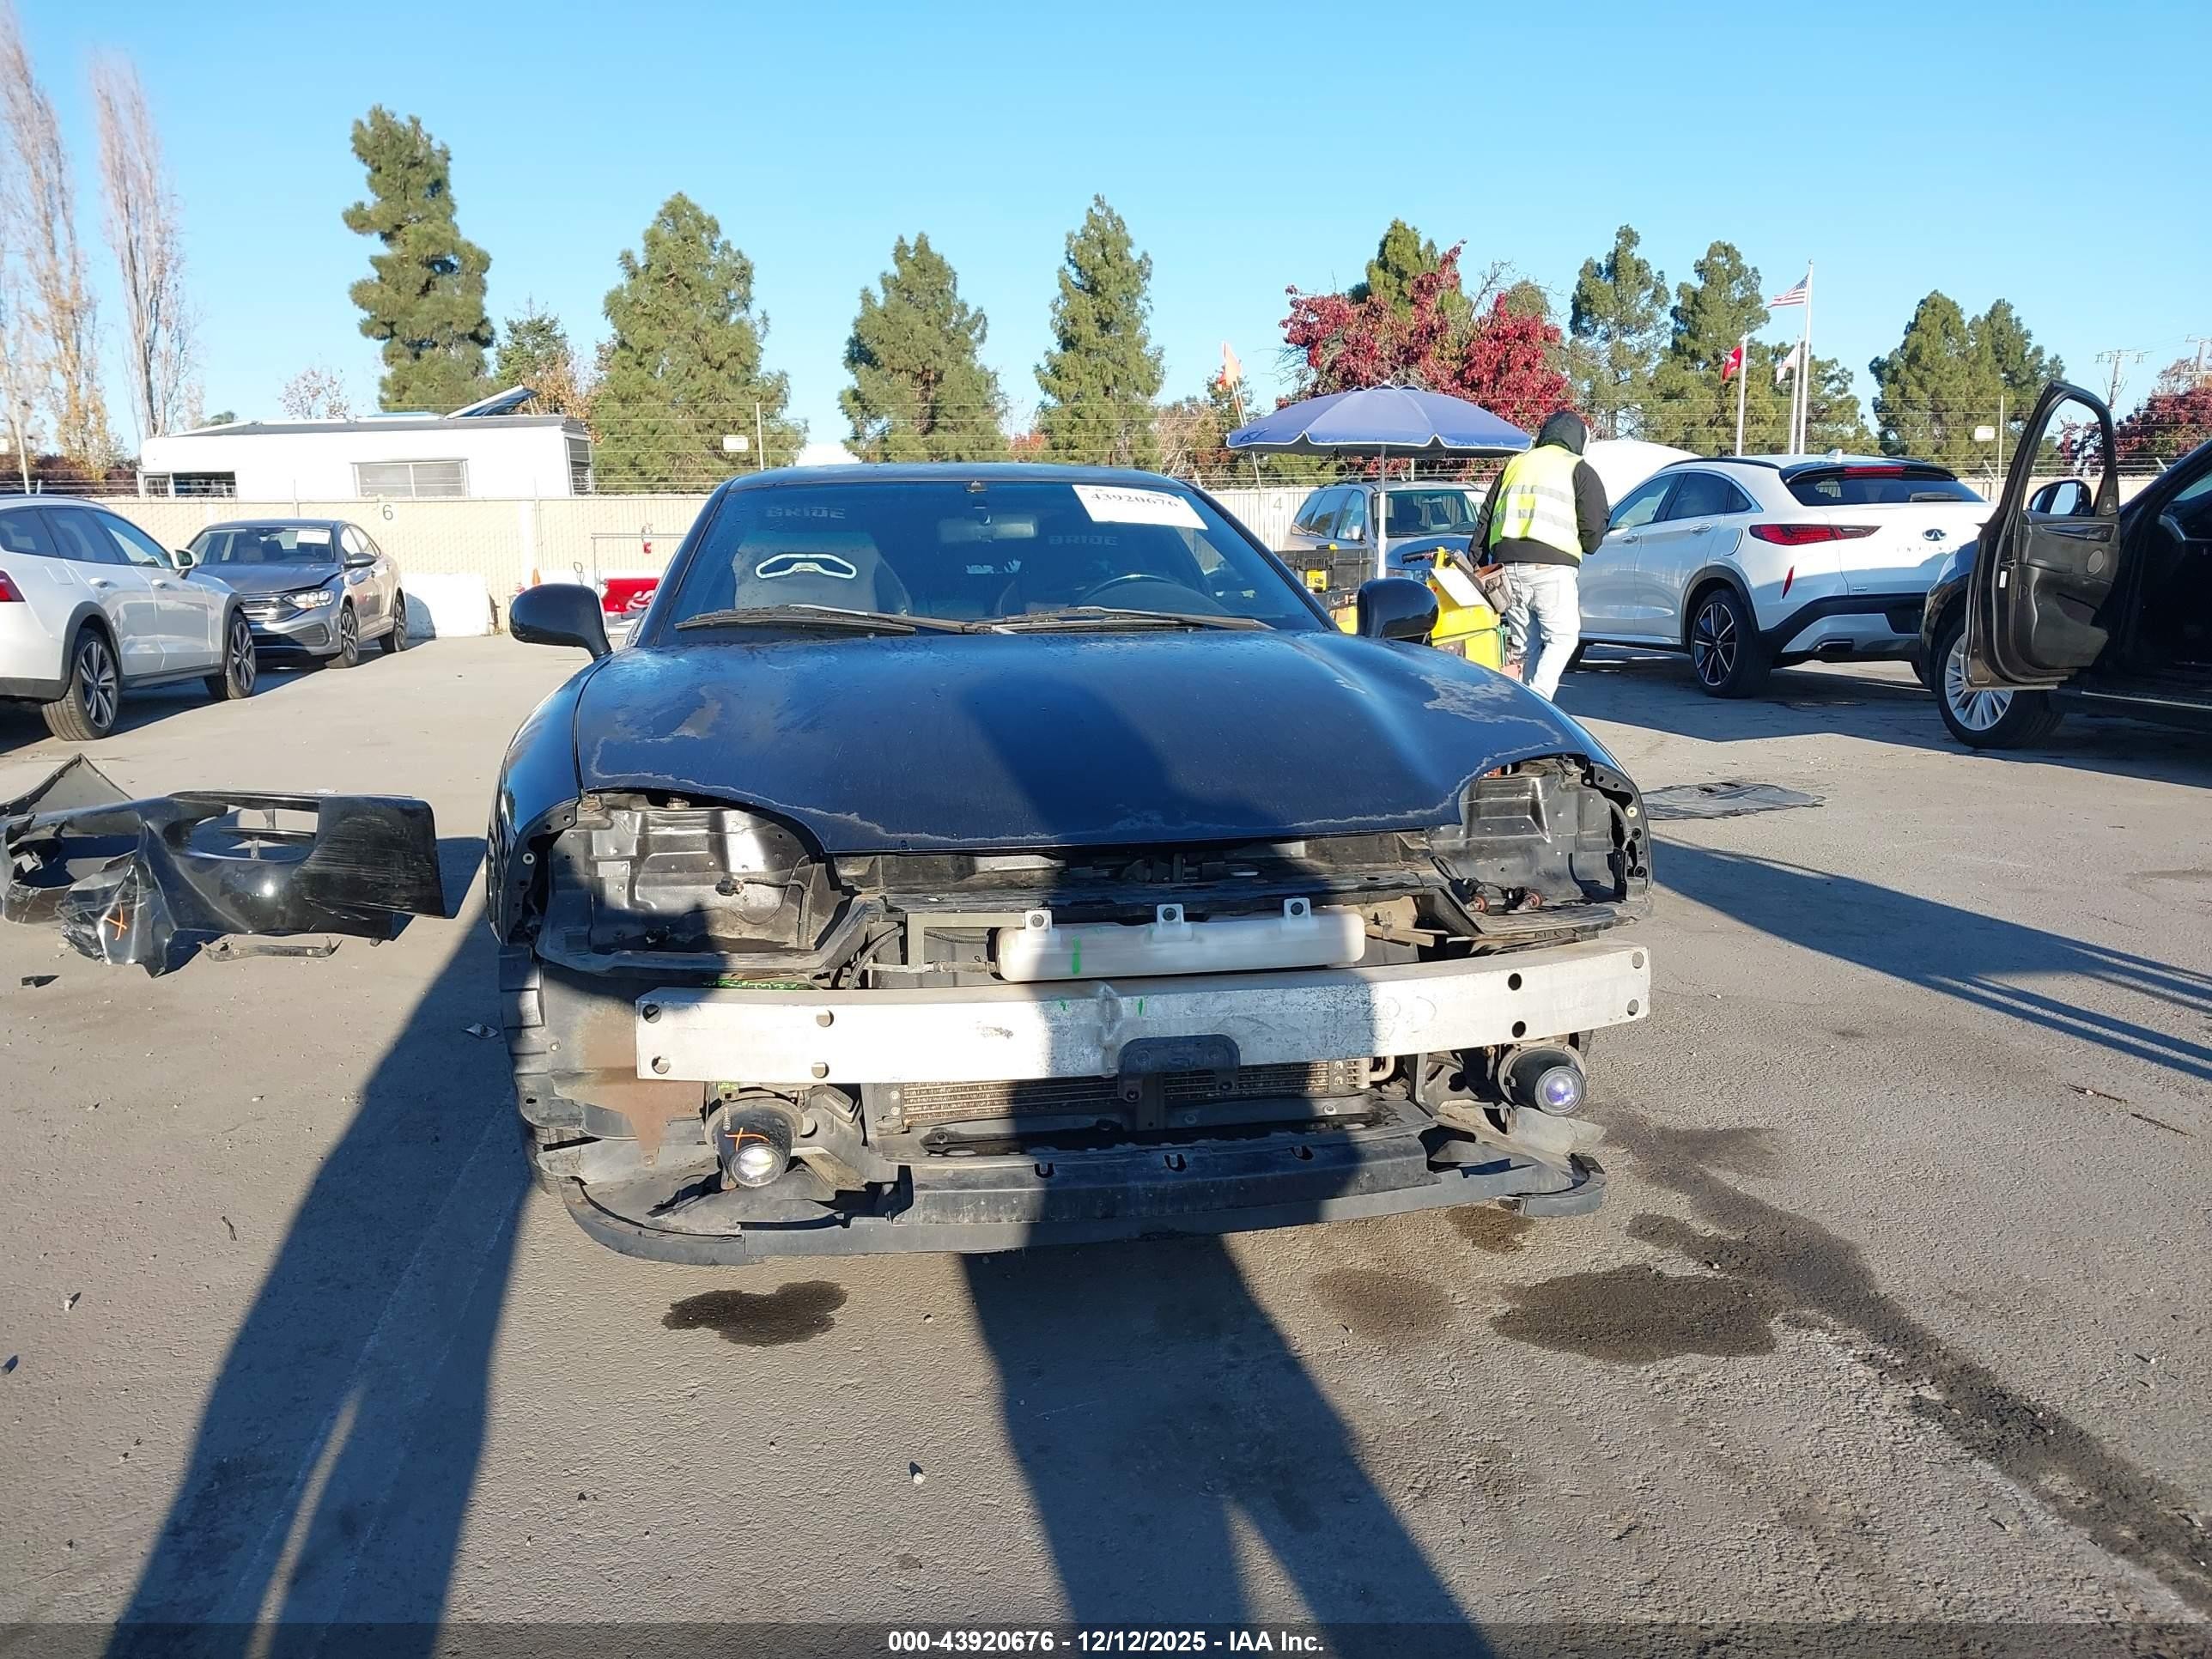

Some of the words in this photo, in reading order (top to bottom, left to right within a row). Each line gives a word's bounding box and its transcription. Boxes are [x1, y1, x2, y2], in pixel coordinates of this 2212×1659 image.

[1091, 492, 1180, 508] 43920676
[1273, 497, 1283, 511] 4
[383, 504, 393, 520] 6
[767, 507, 846, 519] BRIDE
[1049, 535, 1119, 546] BRIDE
